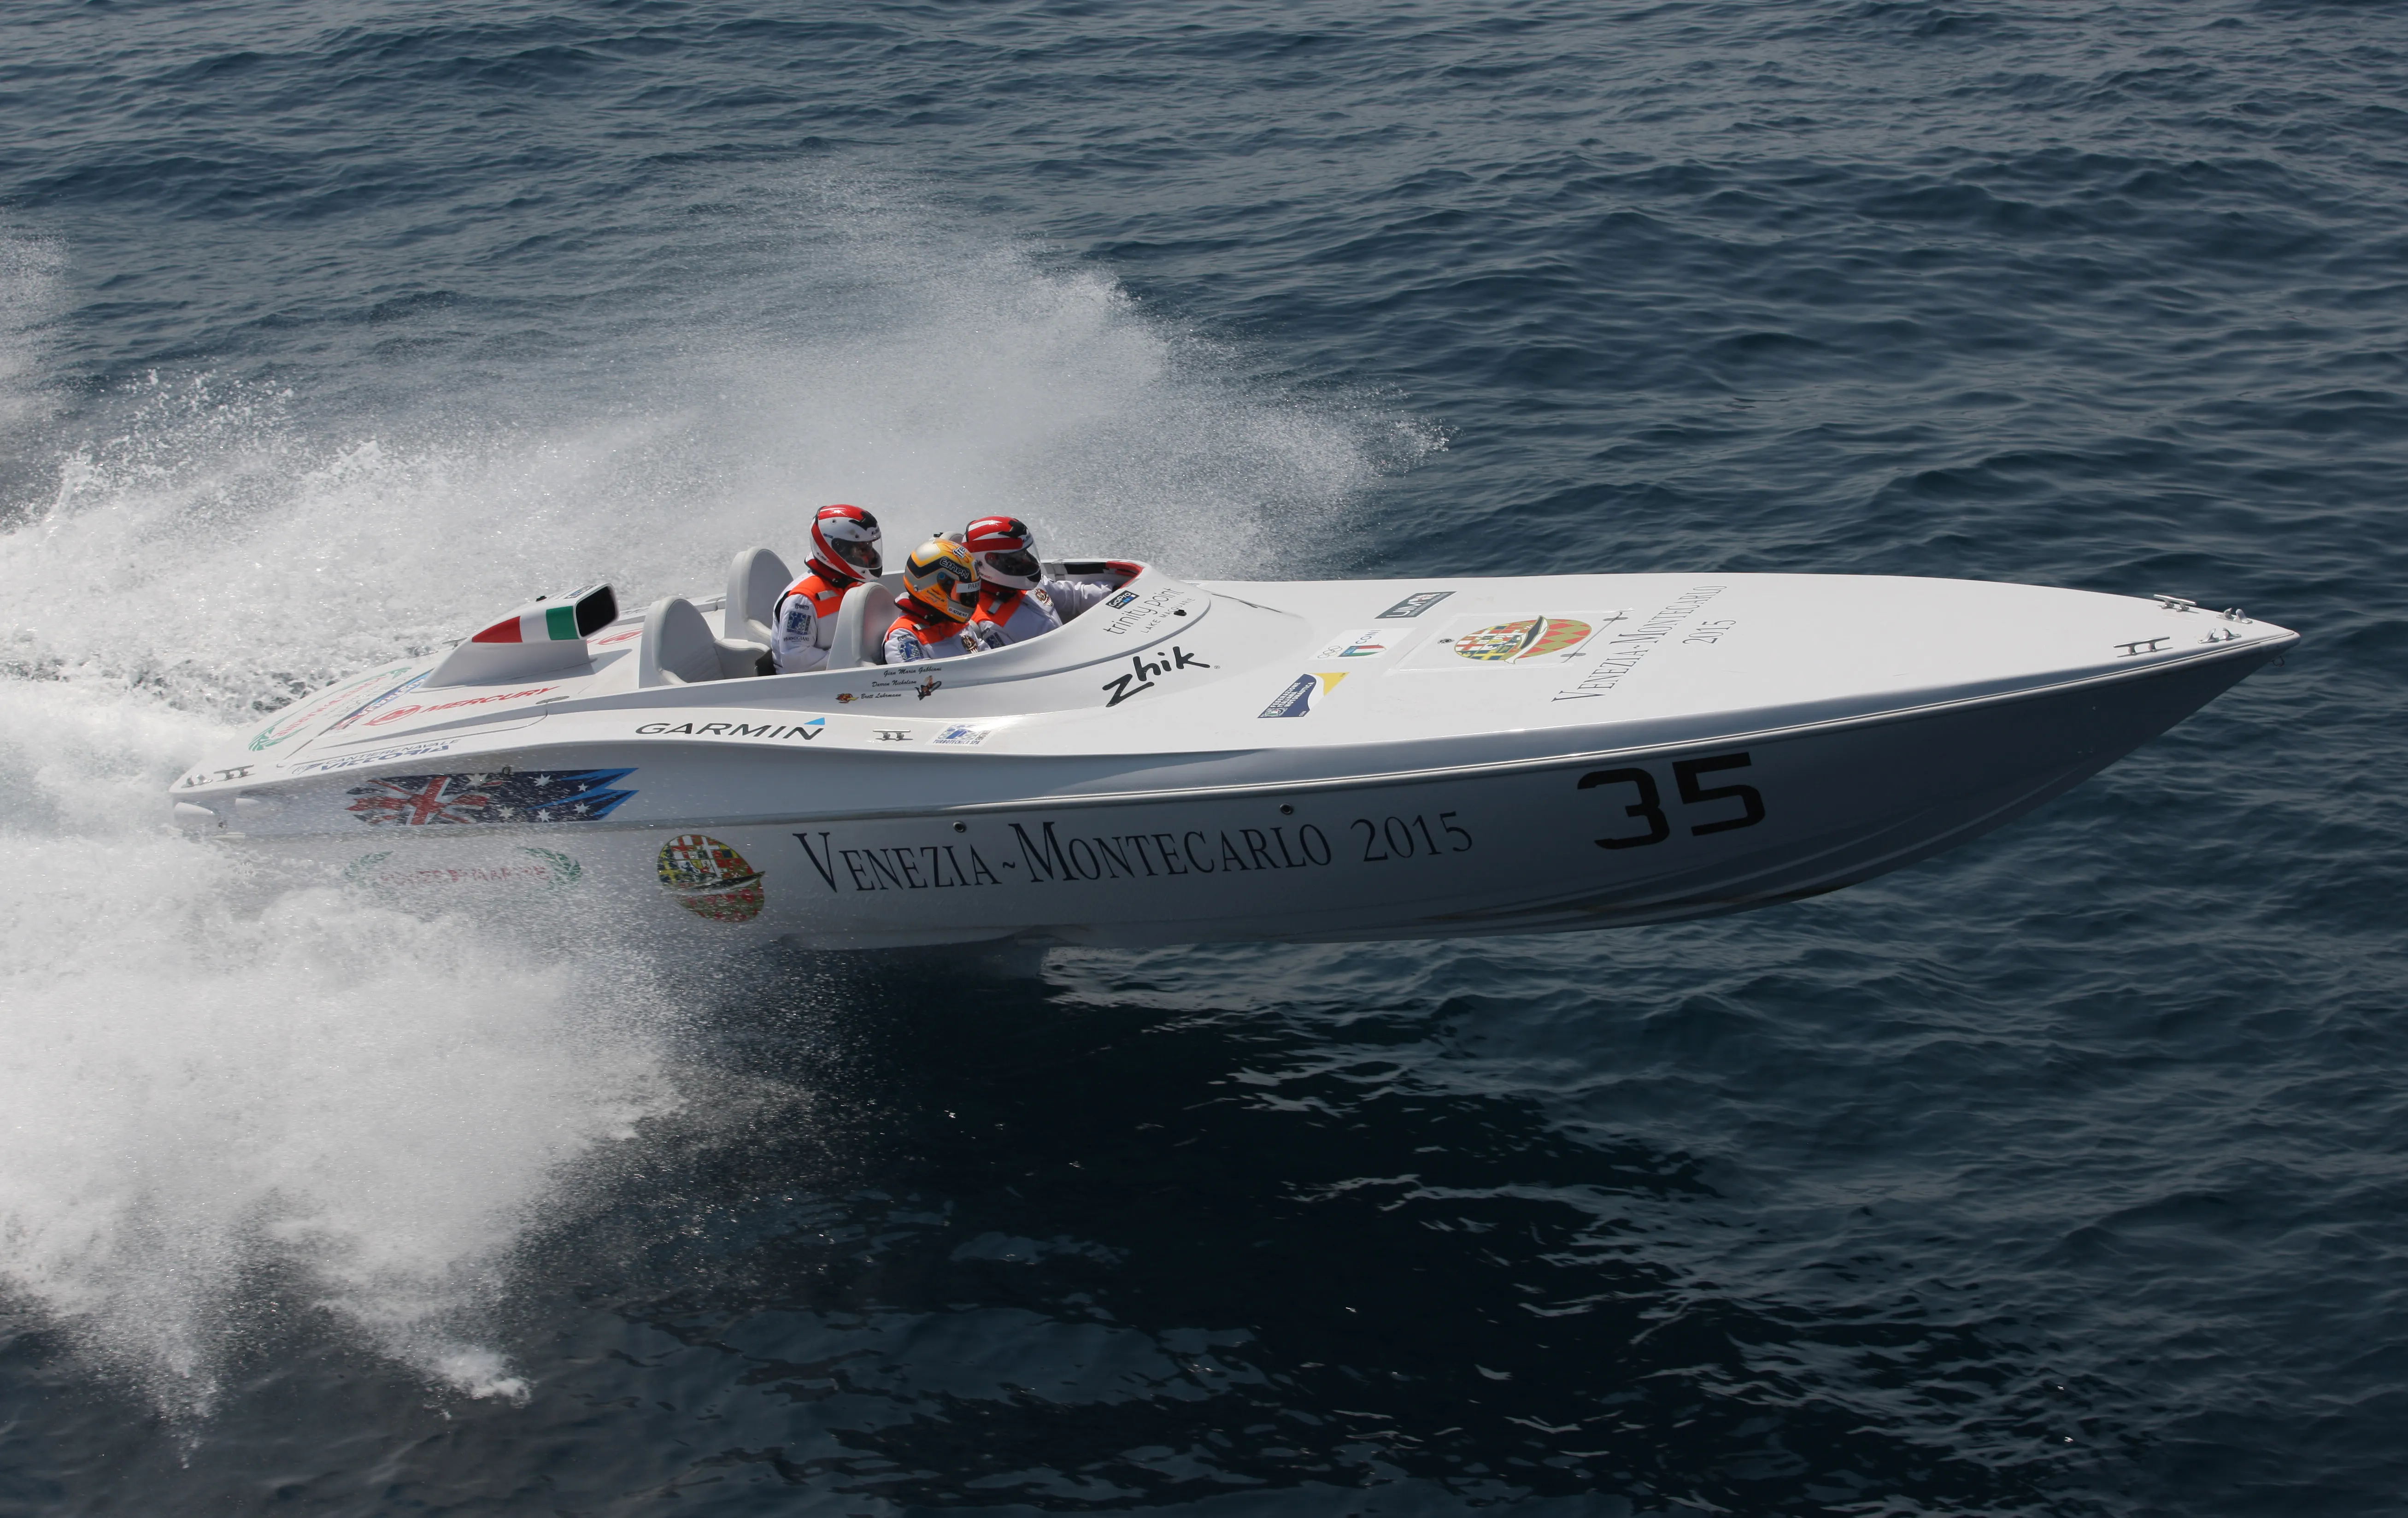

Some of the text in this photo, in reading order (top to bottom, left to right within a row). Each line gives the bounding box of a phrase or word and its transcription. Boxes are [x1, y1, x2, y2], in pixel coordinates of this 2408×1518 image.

[1103, 588, 1184, 635] trinity point
[1109, 592, 1131, 606] GoPro
[1140, 619, 1161, 634] LAKE
[1355, 630, 1381, 644] CONI
[1682, 620, 1736, 644] 2015
[419, 686, 561, 713] MERCURY
[1270, 682, 1301, 707] FEDERAZIONE
[1277, 691, 1298, 707] ITALIANA
[1284, 682, 1315, 707] MOTONAUTICA
[635, 723, 824, 740] GARMIN
[326, 739, 458, 764] CANTIERE NAVALE
[1577, 752, 1766, 850] 35
[1350, 811, 1472, 862] 2015
